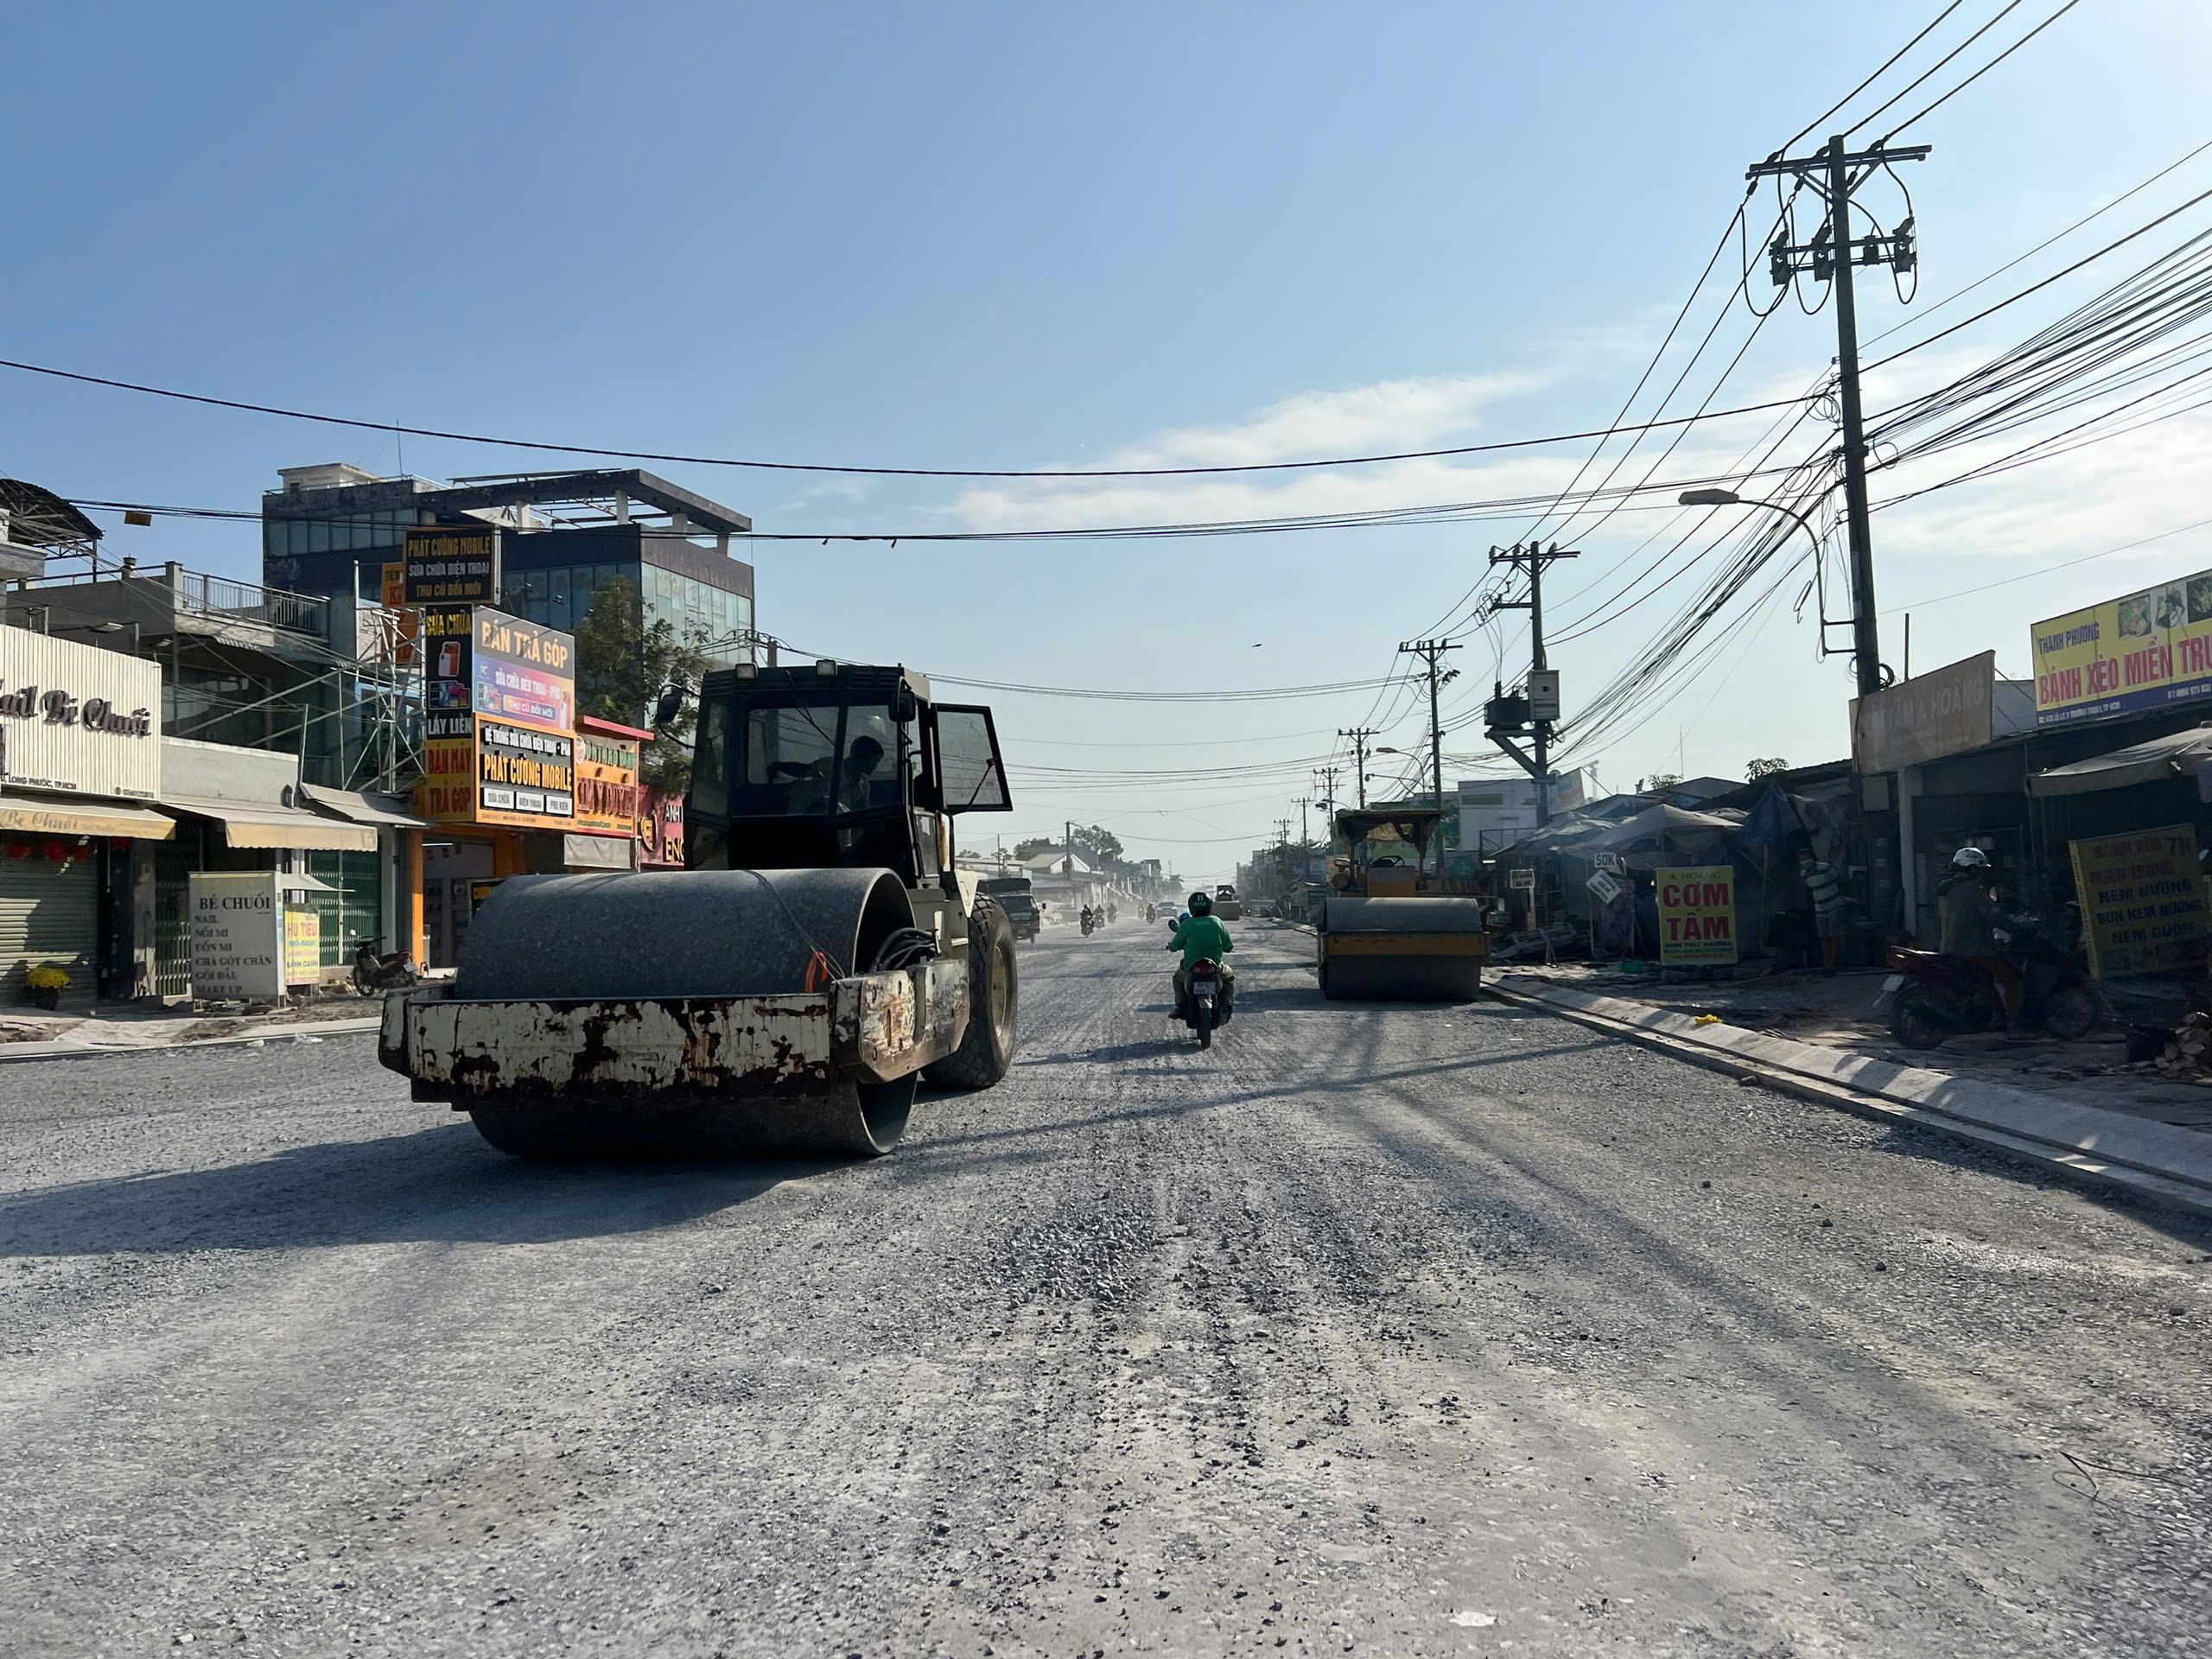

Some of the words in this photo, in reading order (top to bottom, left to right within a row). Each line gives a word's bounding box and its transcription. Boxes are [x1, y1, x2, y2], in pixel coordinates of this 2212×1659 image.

[426, 609, 444, 636] SỬA
[481, 619, 511, 653] BÁN
[514, 631, 540, 663] TRẢ
[543, 639, 568, 669] GÓP
[2038, 633, 2063, 655] THANH
[2066, 622, 2100, 648] PHƯƠNG
[2039, 665, 2082, 705] BÁNH
[2086, 654, 2119, 696] XÈO
[2125, 636, 2173, 686] MIỀN
[81, 698, 152, 740] Chuối
[428, 714, 447, 735] LẤY
[484, 750, 508, 782] PHÁT
[510, 754, 541, 787] CƯỜNG
[542, 763, 573, 791] MOBILE
[1597, 854, 1615, 866] 50K
[200, 894, 219, 910] BÉ
[222, 892, 270, 910] CHUỐI
[1663, 881, 1729, 908] CƠM
[194, 914, 219, 925] NAIL
[1666, 908, 1729, 941] TẤM
